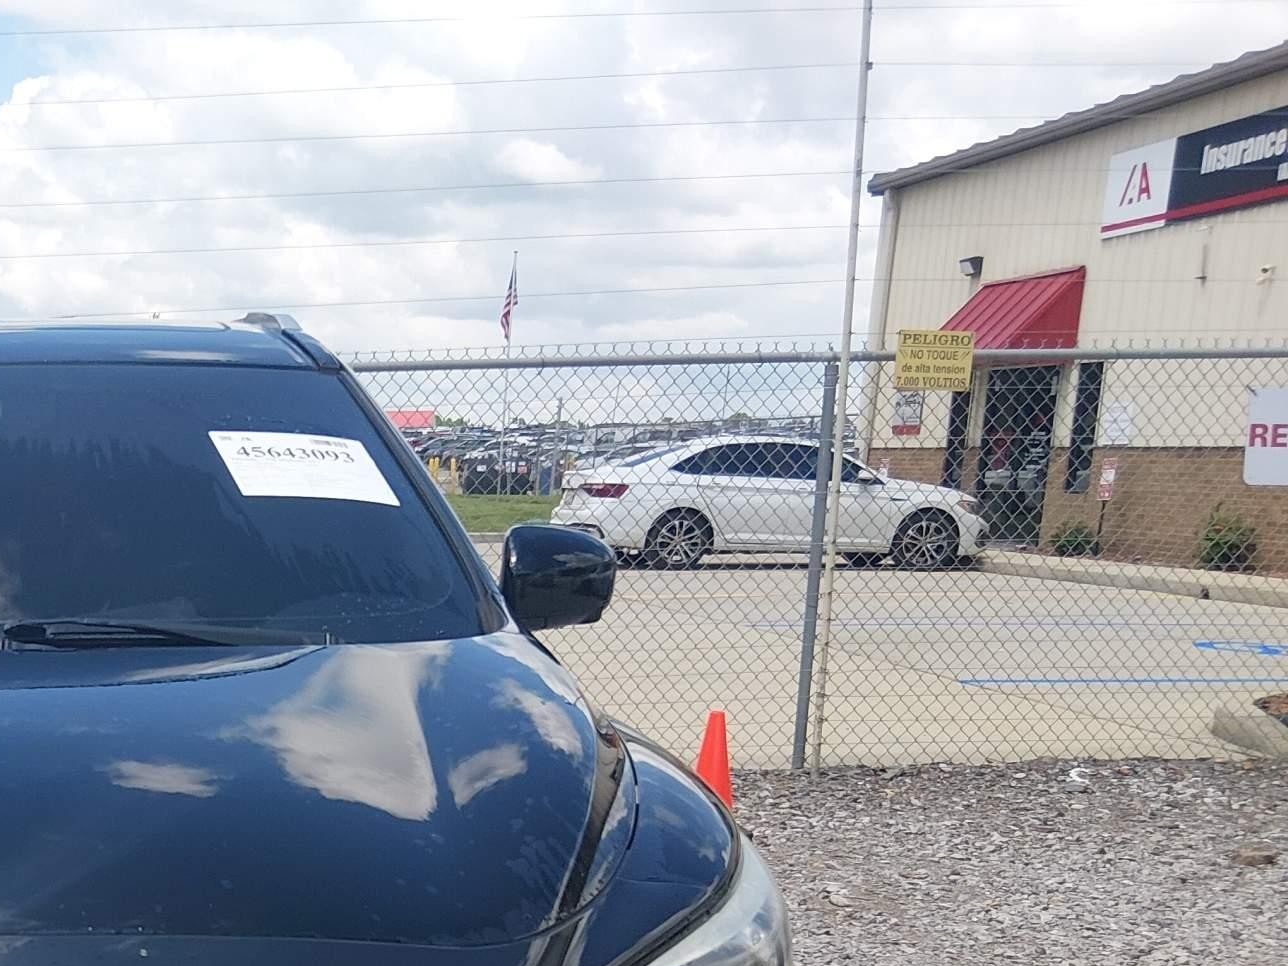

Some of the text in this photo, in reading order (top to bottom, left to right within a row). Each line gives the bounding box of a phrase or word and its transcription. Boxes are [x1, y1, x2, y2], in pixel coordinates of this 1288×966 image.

[1200, 128, 1288, 175] Insurance
[902, 333, 972, 347] PELIGRO
[909, 349, 959, 361] NO TOQUE
[901, 363, 966, 375] de alta tension
[922, 377, 967, 389] VOLTIOS
[236, 446, 355, 463] 45643093
